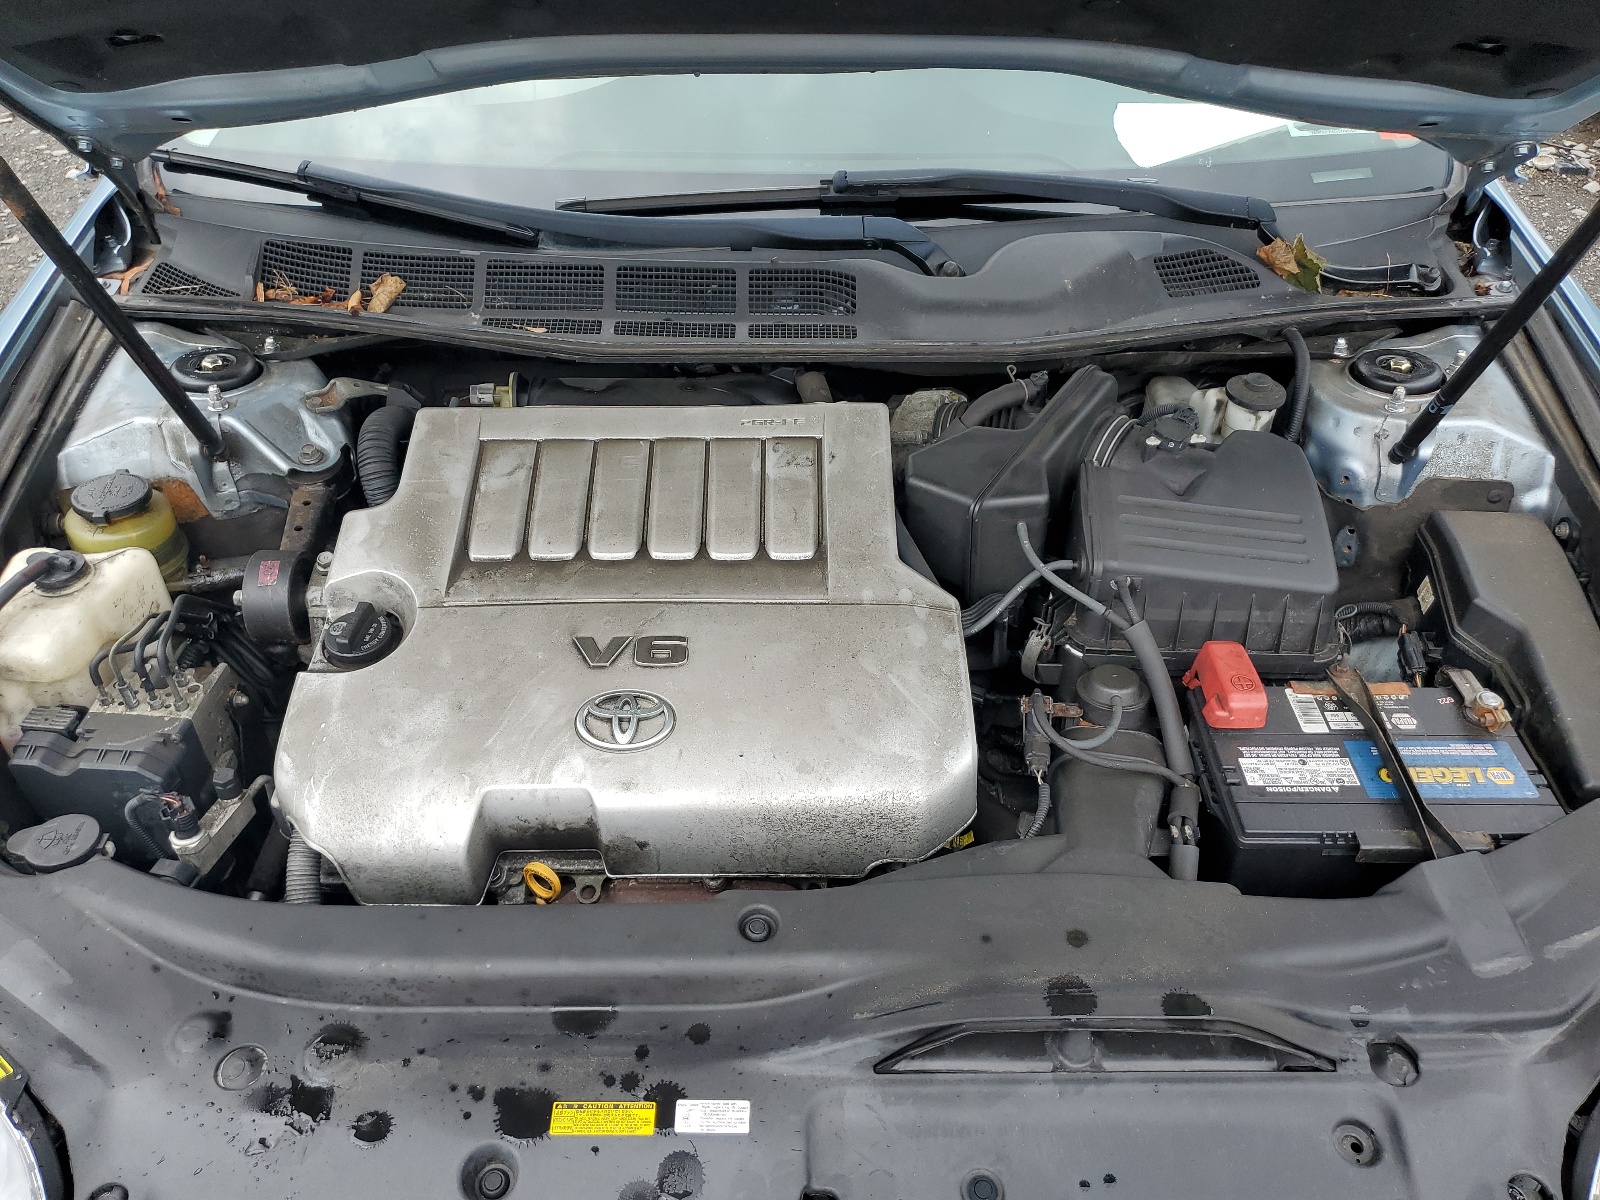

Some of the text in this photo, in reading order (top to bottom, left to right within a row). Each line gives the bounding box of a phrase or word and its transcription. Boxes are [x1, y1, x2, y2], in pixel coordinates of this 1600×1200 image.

[572, 635, 689, 668] V6
[1378, 766, 1512, 785] NAPA LEGED
